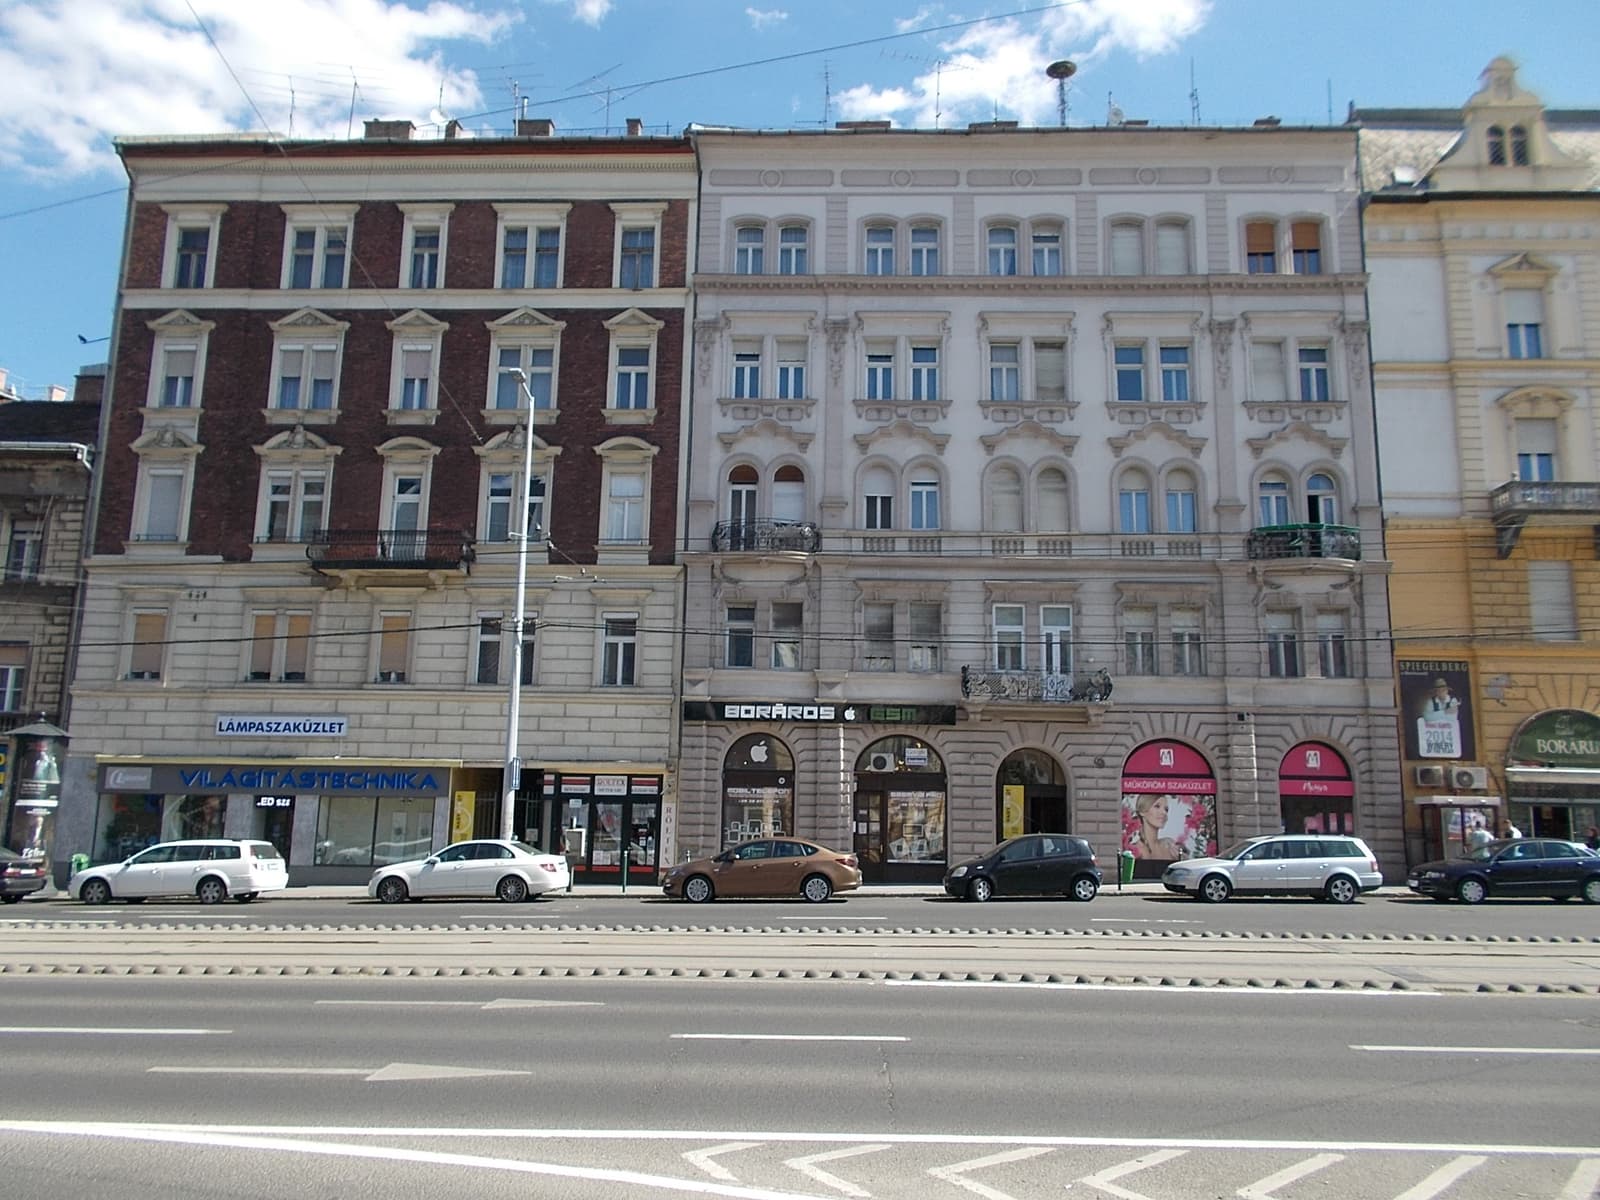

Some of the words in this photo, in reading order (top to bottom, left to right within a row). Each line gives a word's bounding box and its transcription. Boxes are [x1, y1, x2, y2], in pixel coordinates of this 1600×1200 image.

[1400, 661, 1468, 672] SPIEGELBERG
[724, 703, 835, 720] BORÁROS
[218, 719, 344, 733] LÁMPASZAKÜZLET
[1425, 730, 1453, 742] 2014
[179, 768, 438, 790] VILÁGÍTÁSTECHNIKA
[1167, 781, 1212, 790] SZAKÜZLET
